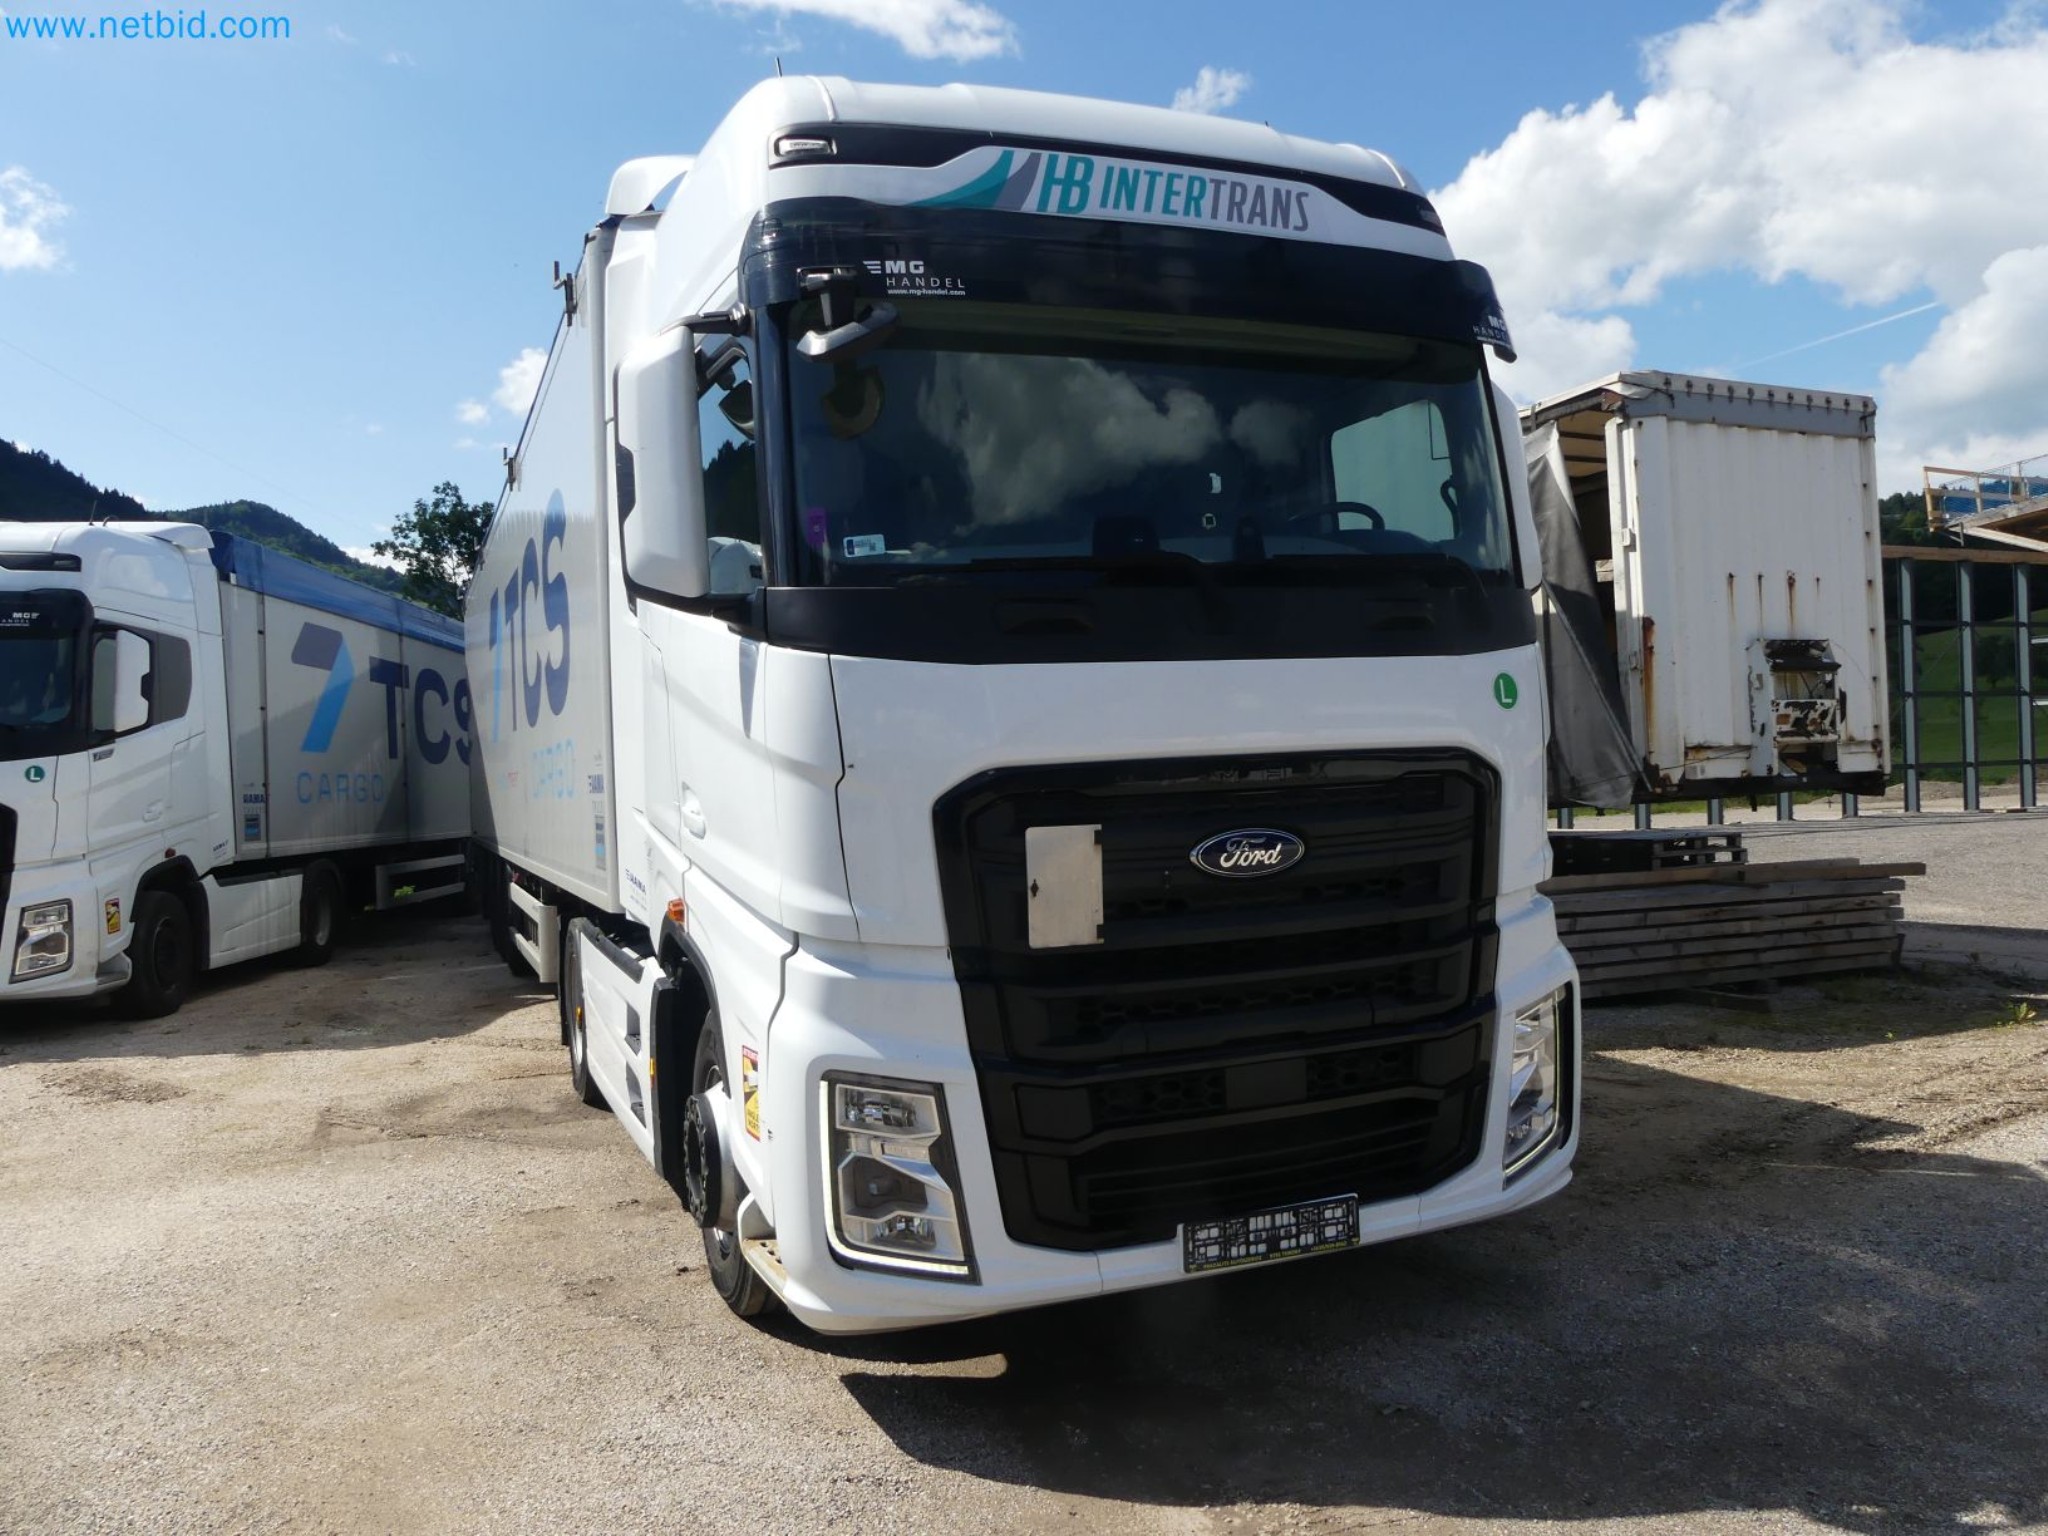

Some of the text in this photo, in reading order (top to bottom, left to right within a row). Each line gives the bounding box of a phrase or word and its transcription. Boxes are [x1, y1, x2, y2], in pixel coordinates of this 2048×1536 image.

[1036, 153, 1309, 232] HB INTERTRANS
[885, 260, 925, 274] MG
[886, 277, 965, 288] HANDEL
[296, 771, 385, 804] CARGO
[1219, 837, 1283, 868] Ford
